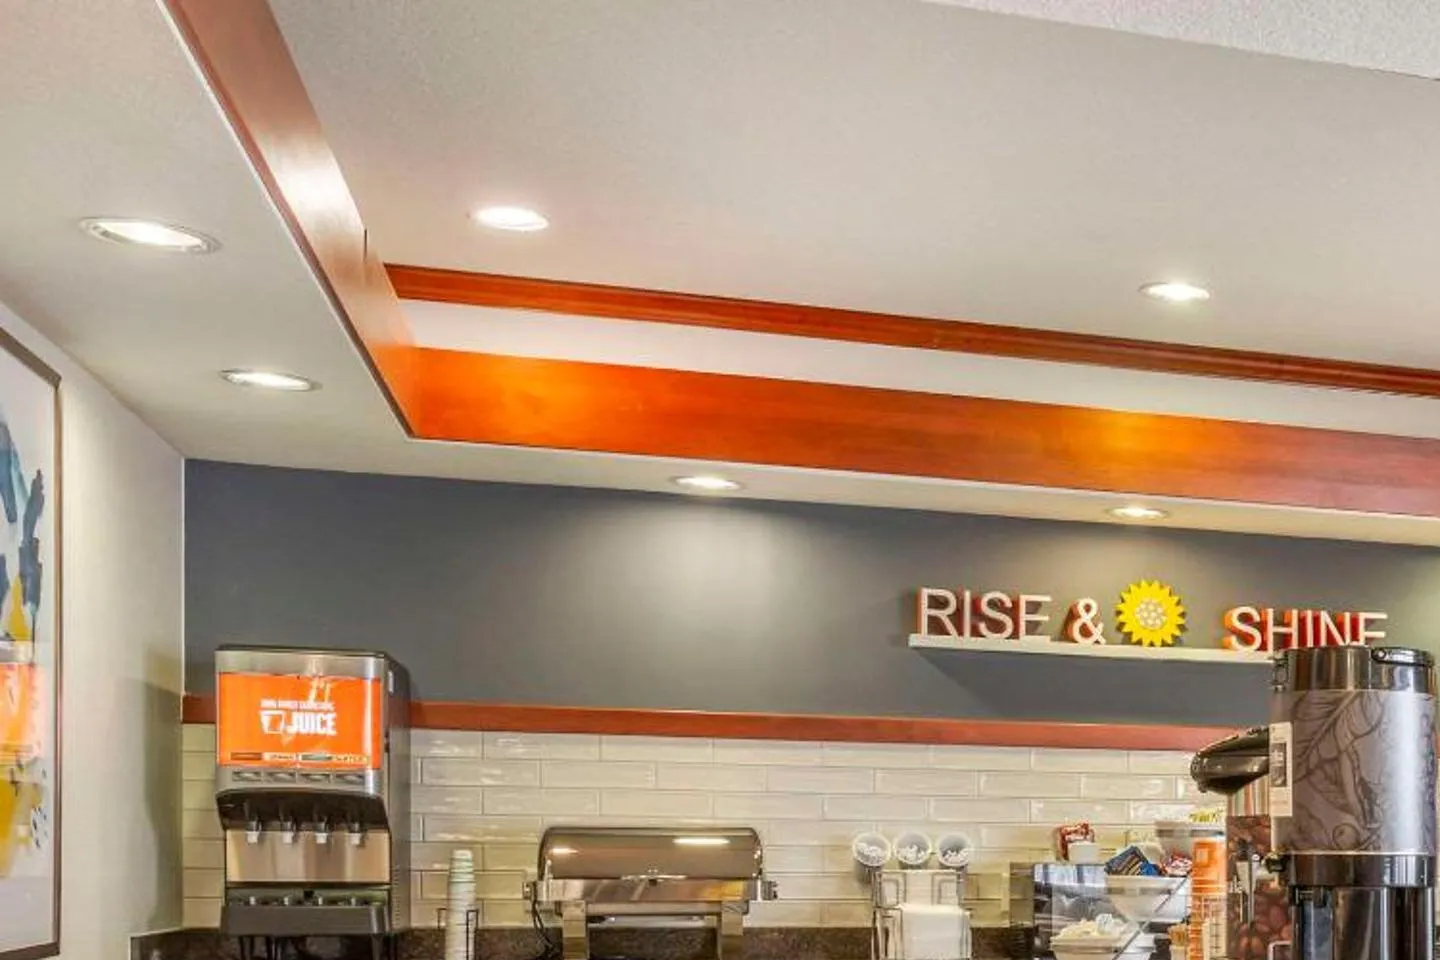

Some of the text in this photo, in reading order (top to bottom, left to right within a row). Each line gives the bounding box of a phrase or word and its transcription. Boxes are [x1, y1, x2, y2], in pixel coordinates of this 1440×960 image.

[919, 587, 1388, 655] RISE & SHINE
[287, 711, 337, 736] JUICE
